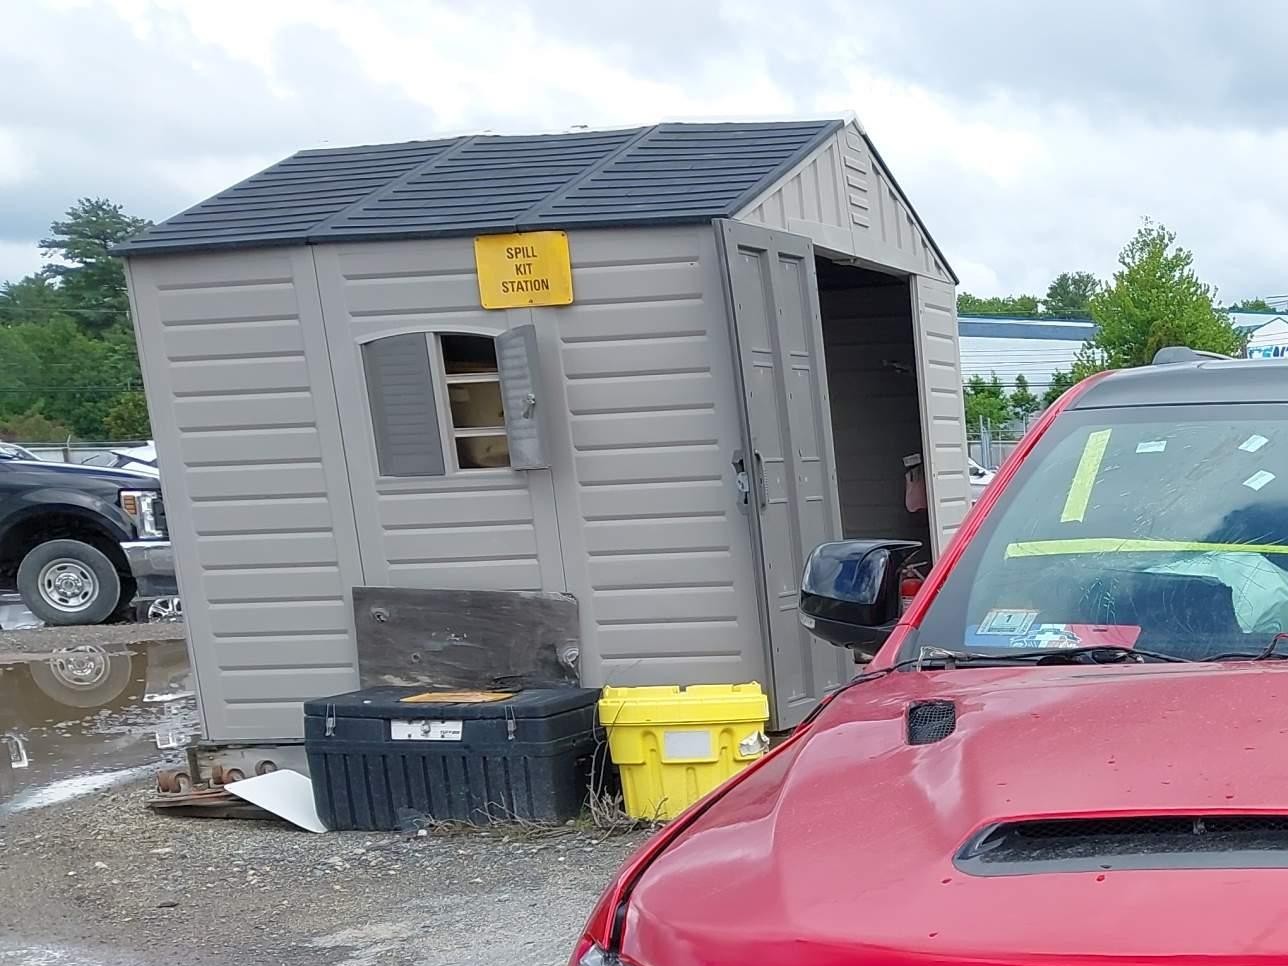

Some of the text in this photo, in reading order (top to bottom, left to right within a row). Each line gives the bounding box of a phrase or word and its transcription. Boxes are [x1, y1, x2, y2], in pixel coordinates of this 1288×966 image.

[506, 247, 537, 259] SPILL
[515, 263, 532, 275] KIT
[502, 279, 549, 293] STATION
